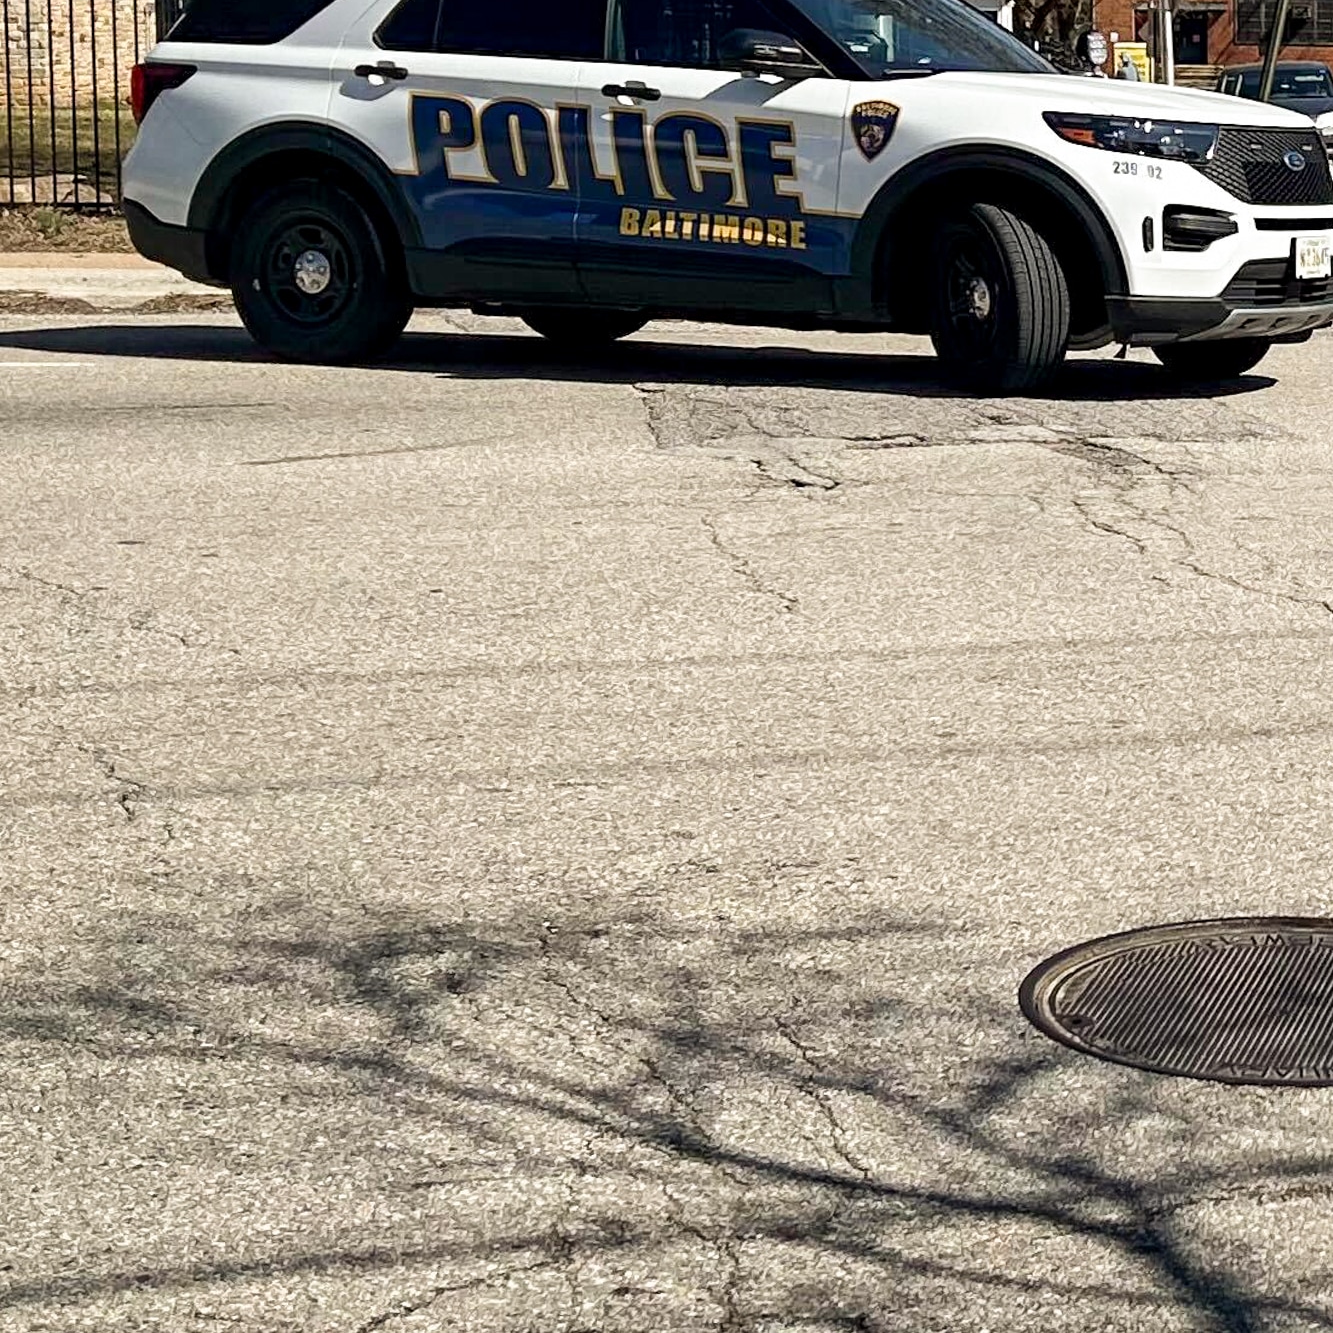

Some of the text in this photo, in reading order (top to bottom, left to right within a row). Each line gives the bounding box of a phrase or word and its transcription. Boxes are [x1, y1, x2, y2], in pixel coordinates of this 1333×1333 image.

[408, 90, 805, 211] POLICE
[1113, 161, 1138, 176] 239
[619, 207, 807, 250] BALTIMORE
